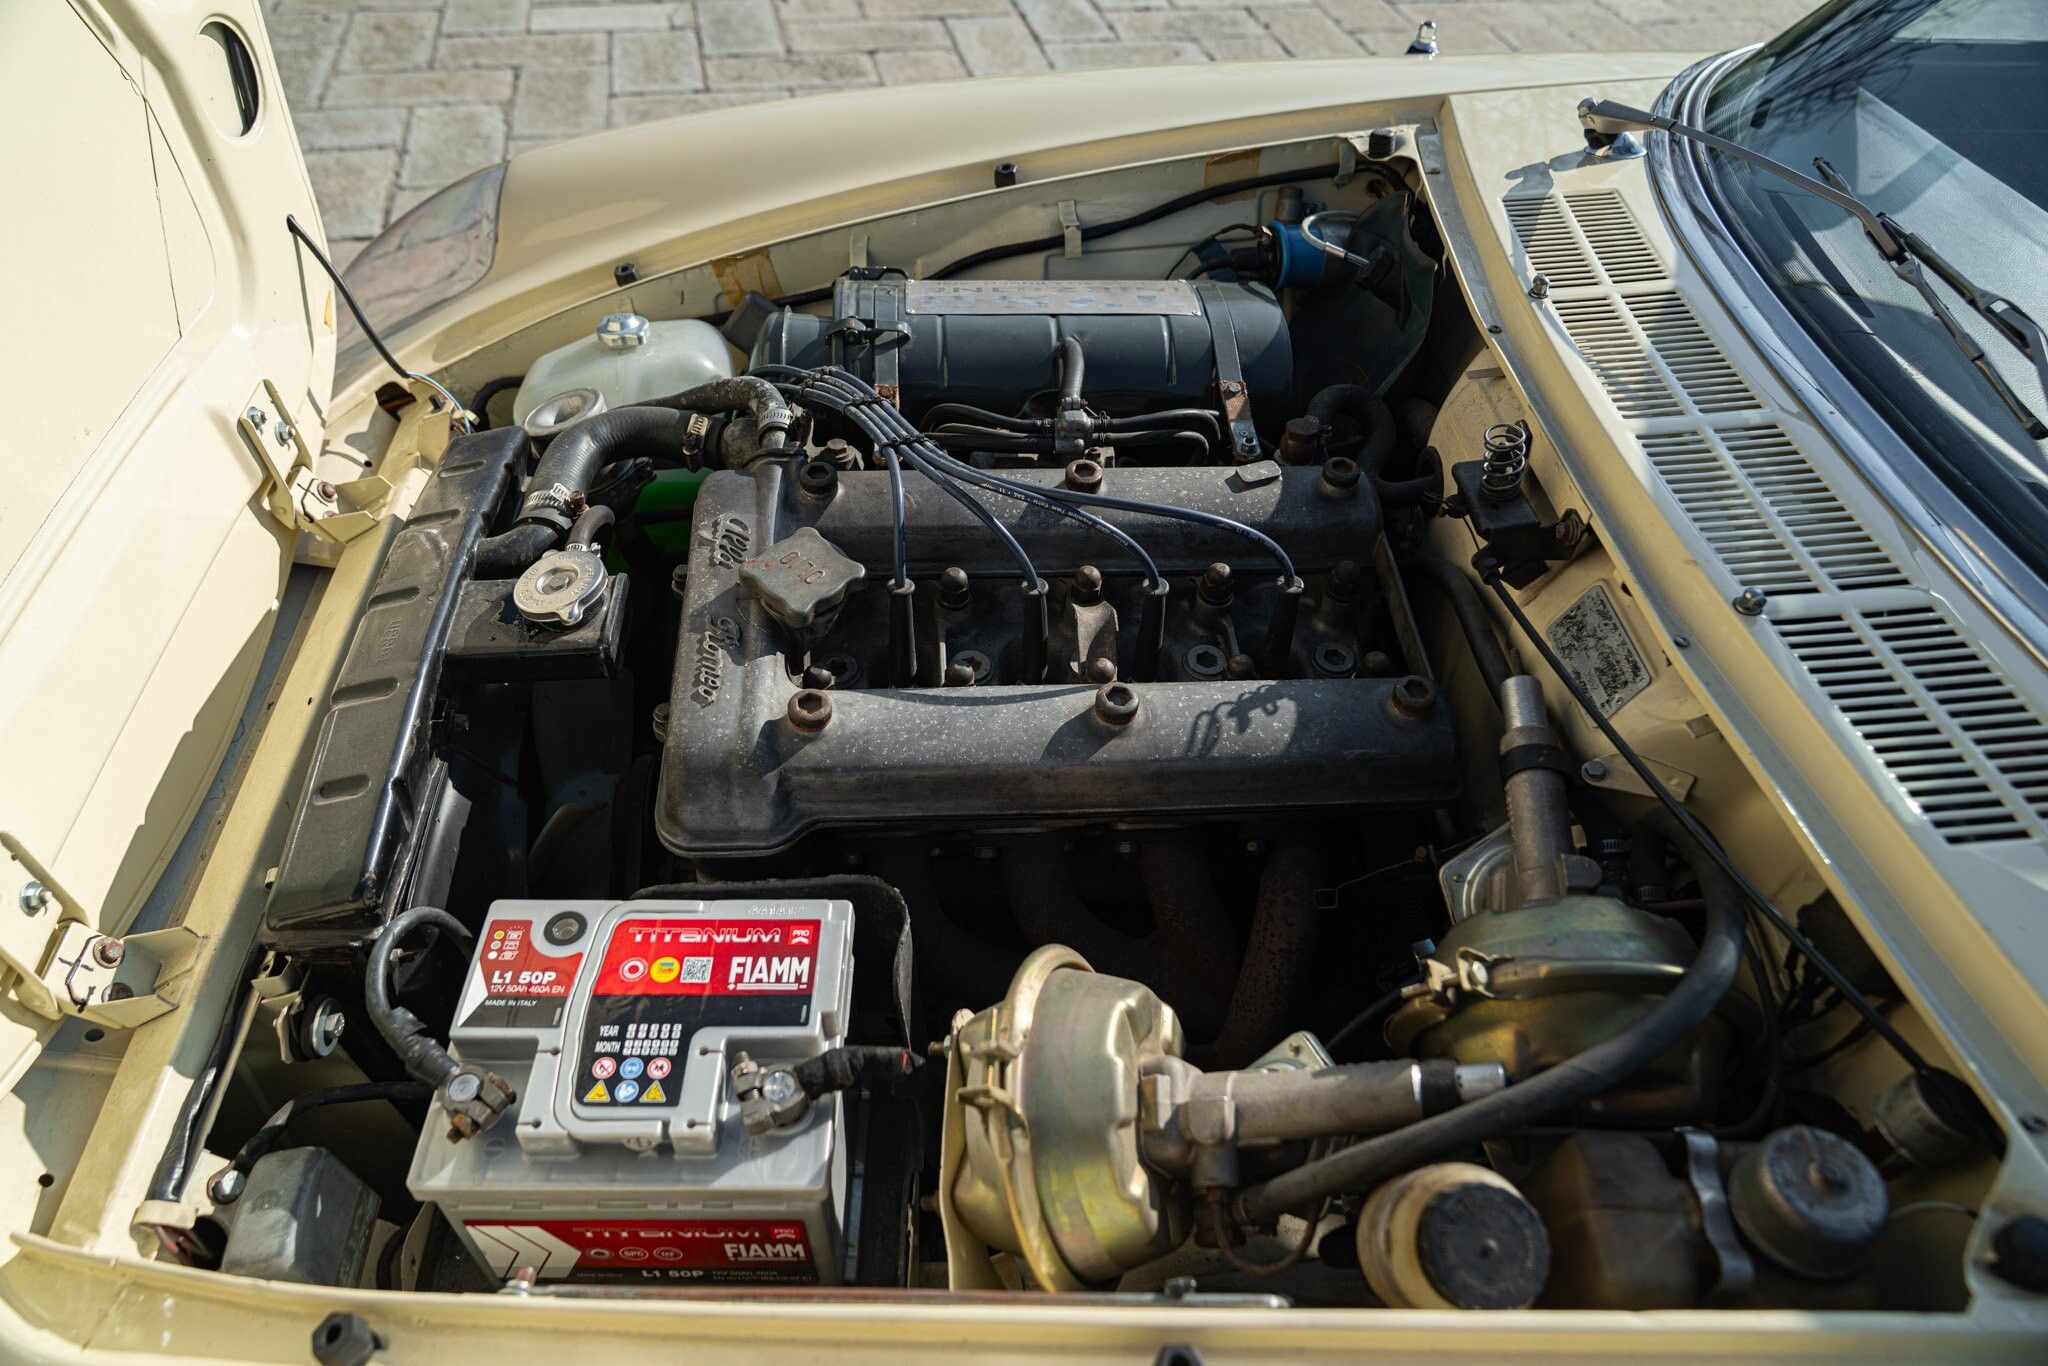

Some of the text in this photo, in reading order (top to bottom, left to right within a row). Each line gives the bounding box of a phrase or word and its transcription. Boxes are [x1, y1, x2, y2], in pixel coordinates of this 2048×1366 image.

[698, 615, 741, 703] Romeo
[792, 929, 810, 937] PRO
[728, 956, 811, 984] FIAMM
[492, 970, 557, 984] L1 50P
[490, 985, 504, 993] 12V
[506, 985, 528, 993] 50Ah
[551, 985, 566, 993] EN
[599, 1025, 620, 1037] YEAR
[594, 1041, 622, 1053] MONTH
[724, 1243, 806, 1258] FIAMM
[641, 1270, 661, 1278] L1
[668, 1270, 704, 1278] 50P
